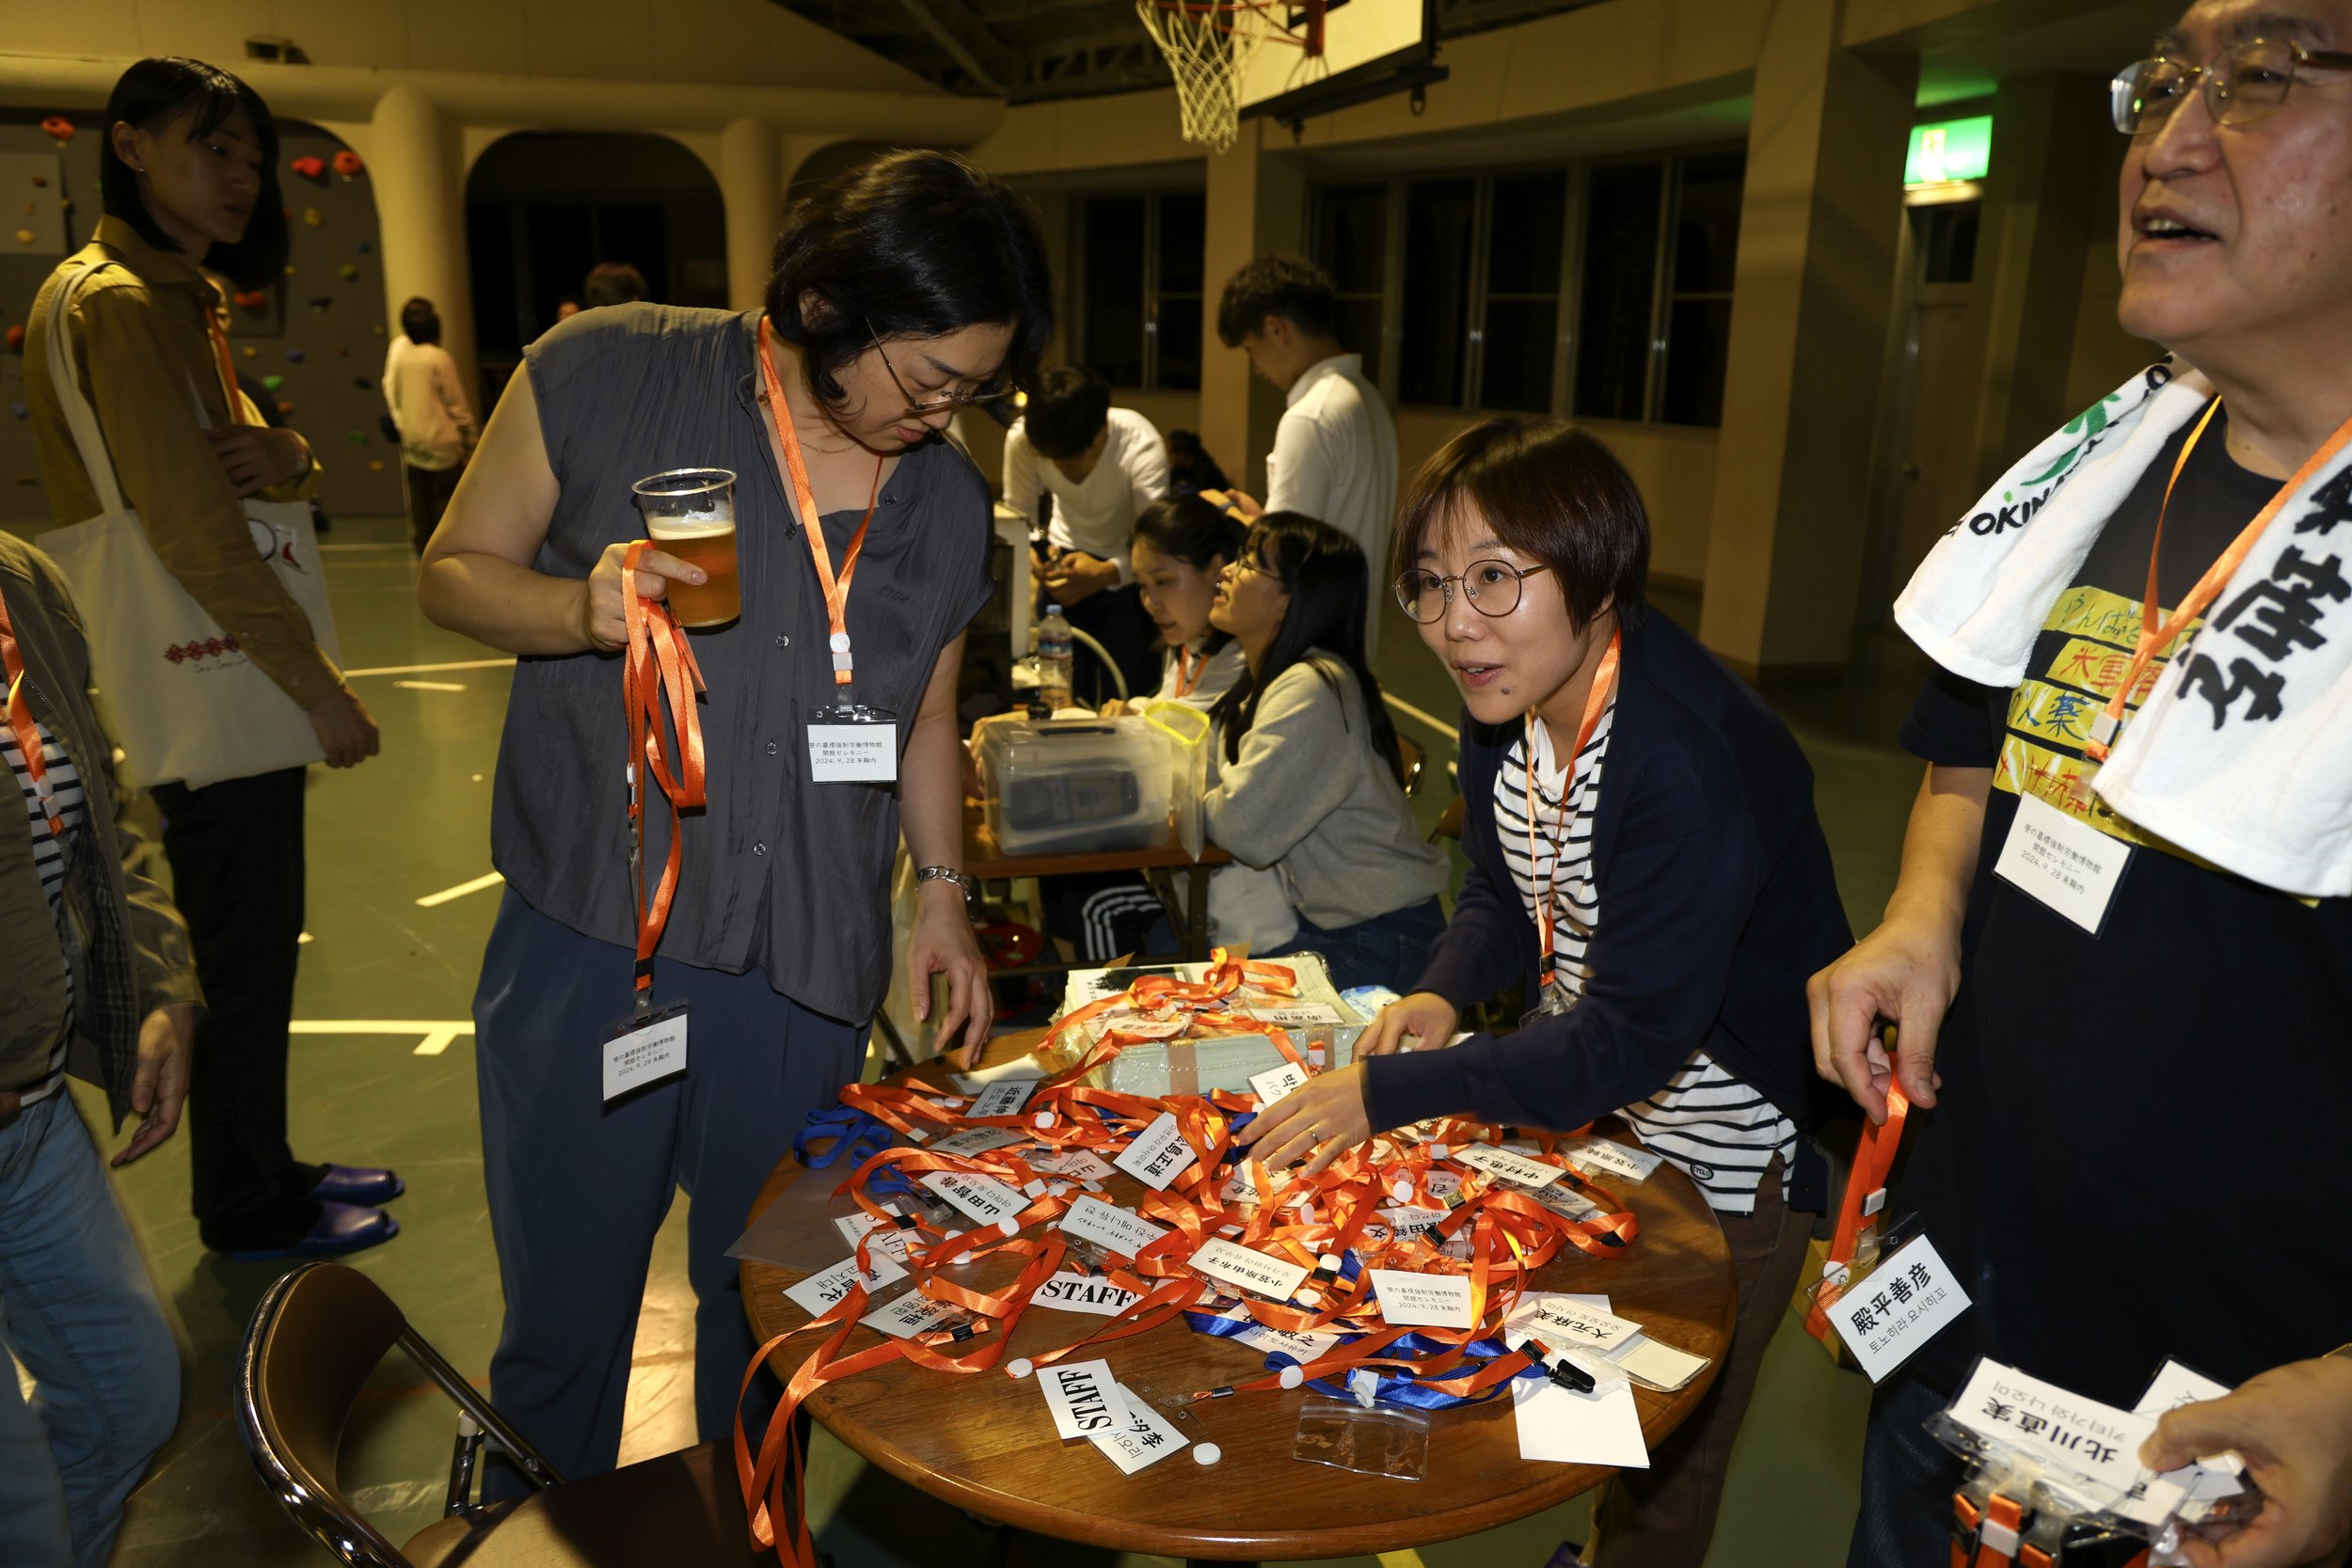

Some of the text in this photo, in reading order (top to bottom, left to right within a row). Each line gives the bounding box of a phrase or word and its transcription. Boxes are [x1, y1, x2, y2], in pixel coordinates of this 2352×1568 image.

[865, 1213, 907, 1256] SAFF
[1041, 1279, 1137, 1307] STAFF
[1850, 1261, 1933, 1337] 殿平善彦
[1057, 1370, 1113, 1431] STAFF
[1980, 1396, 2120, 1465] 北川直実
